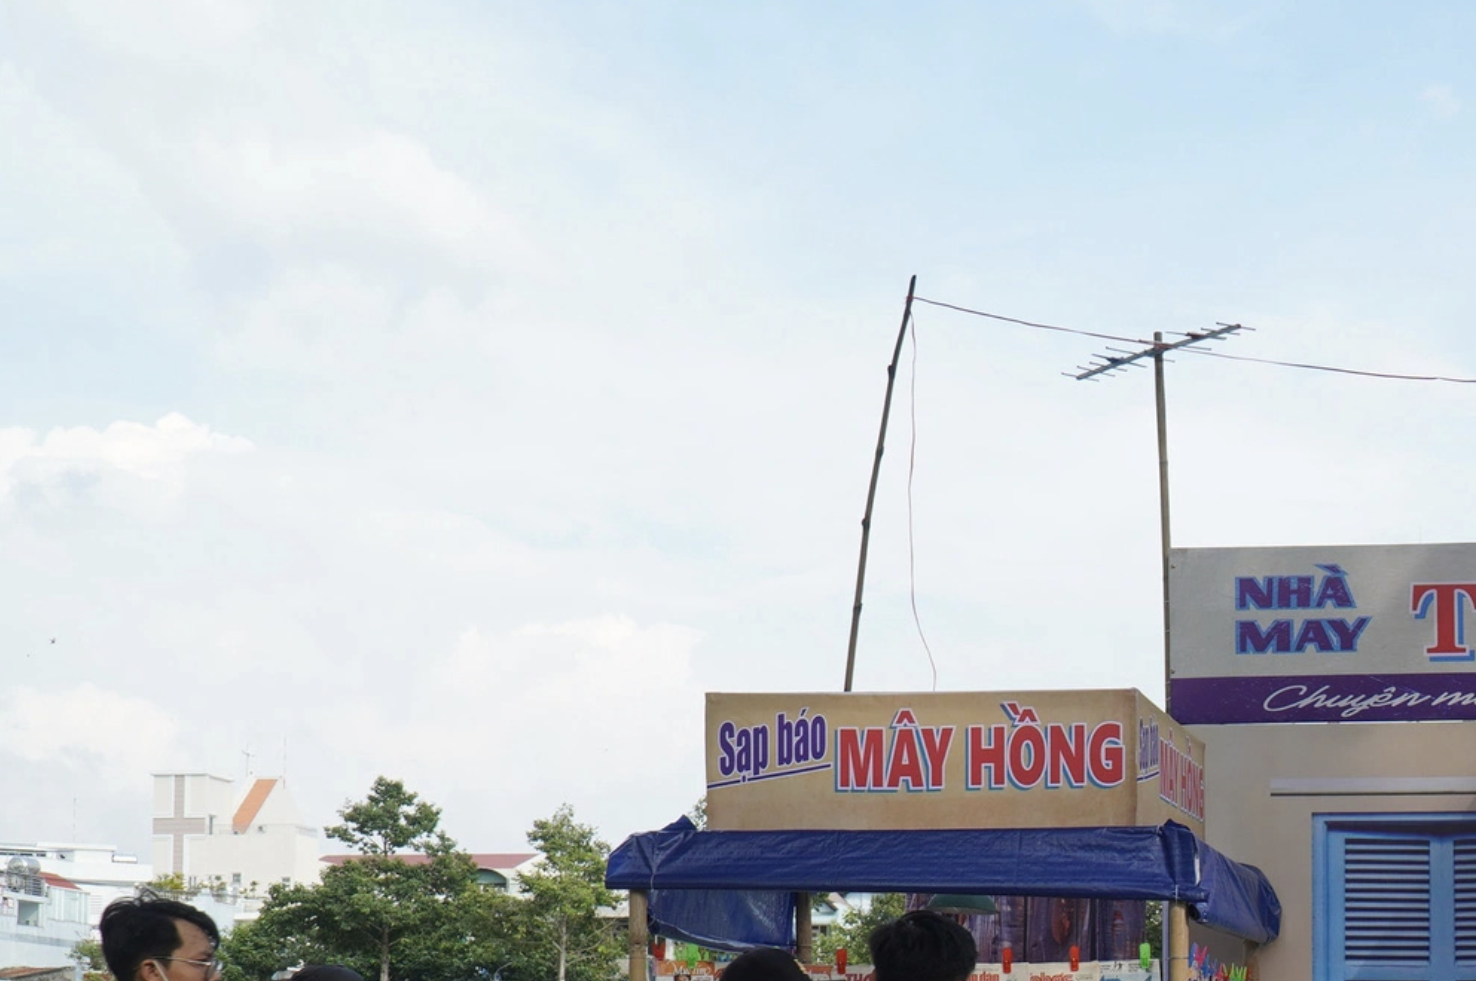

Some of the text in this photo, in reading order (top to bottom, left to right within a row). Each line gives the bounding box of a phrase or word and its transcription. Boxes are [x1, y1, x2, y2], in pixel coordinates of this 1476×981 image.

[1235, 564, 1357, 611] NHÀ
[1235, 616, 1372, 655] MAY
[1263, 684, 1431, 718] Chuyên
[718, 707, 828, 784] Sạp báo
[834, 701, 1127, 792] MÂY HỒNG
